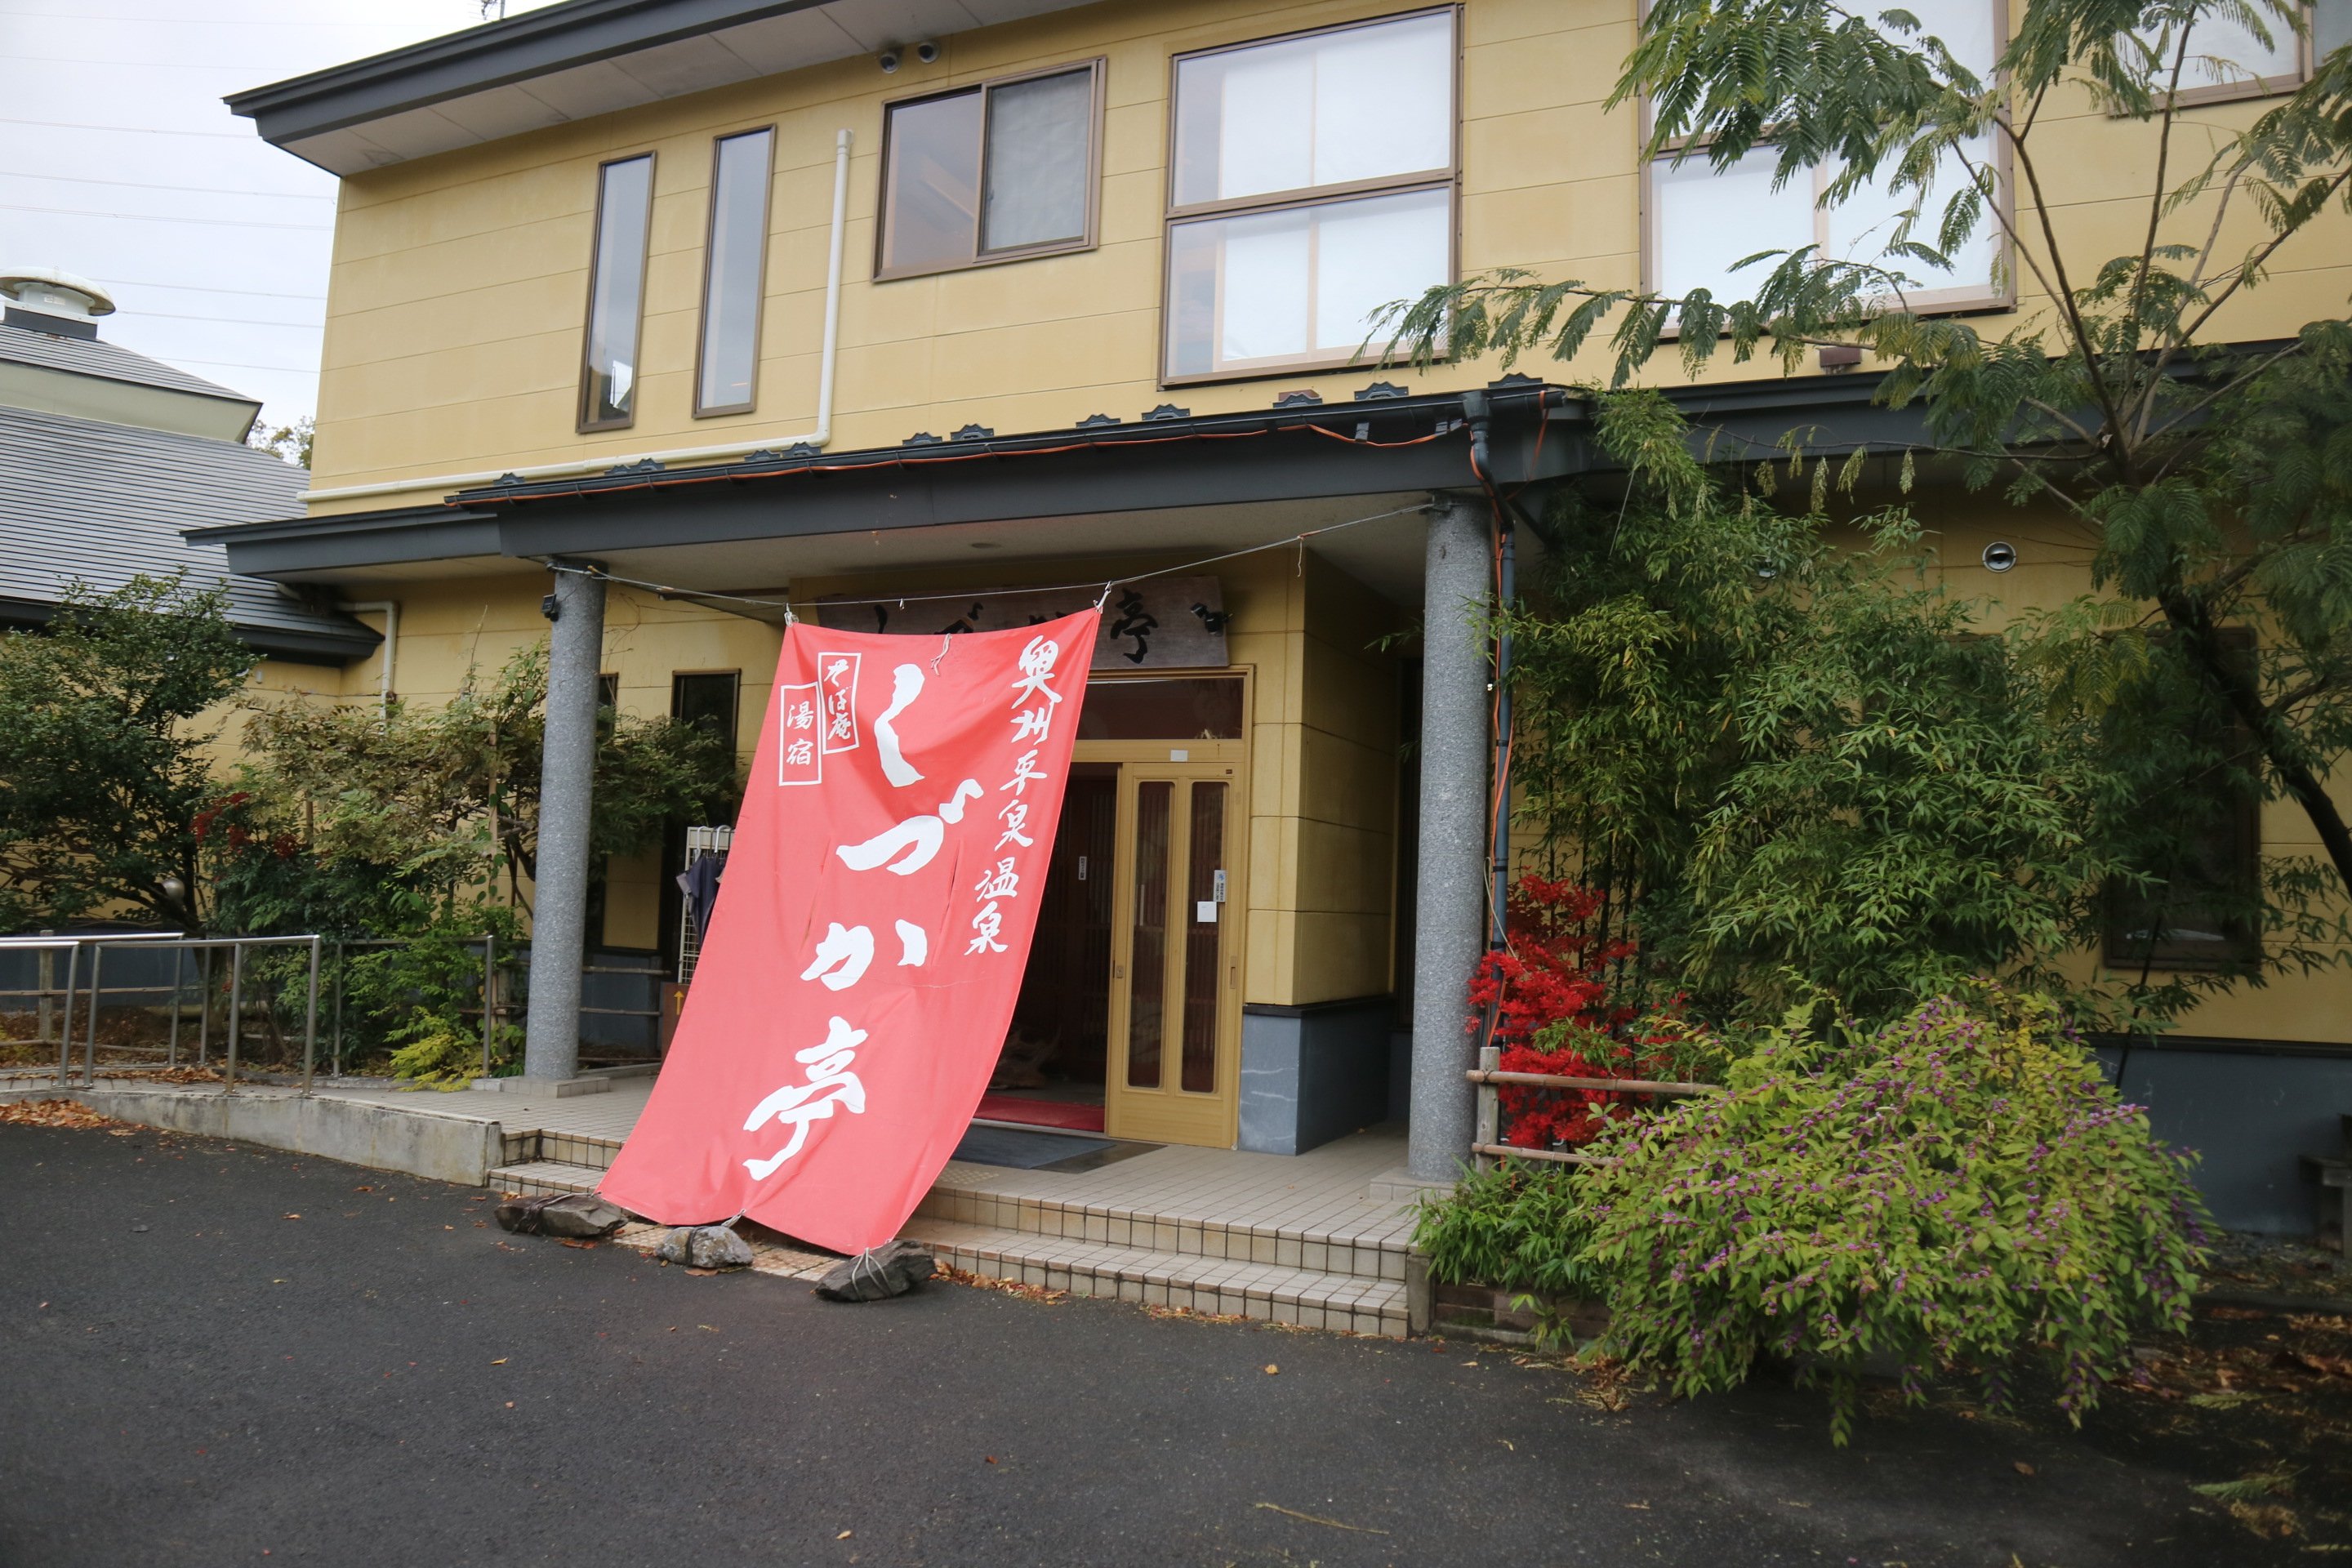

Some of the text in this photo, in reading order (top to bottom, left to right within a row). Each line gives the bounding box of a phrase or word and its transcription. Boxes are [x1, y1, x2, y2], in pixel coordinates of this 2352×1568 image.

[786, 700, 814, 766] 湯宿
[823, 658, 853, 741] そば庵
[963, 635, 1063, 956] 奥州平泉温泉
[742, 662, 985, 1182] しづか亭
